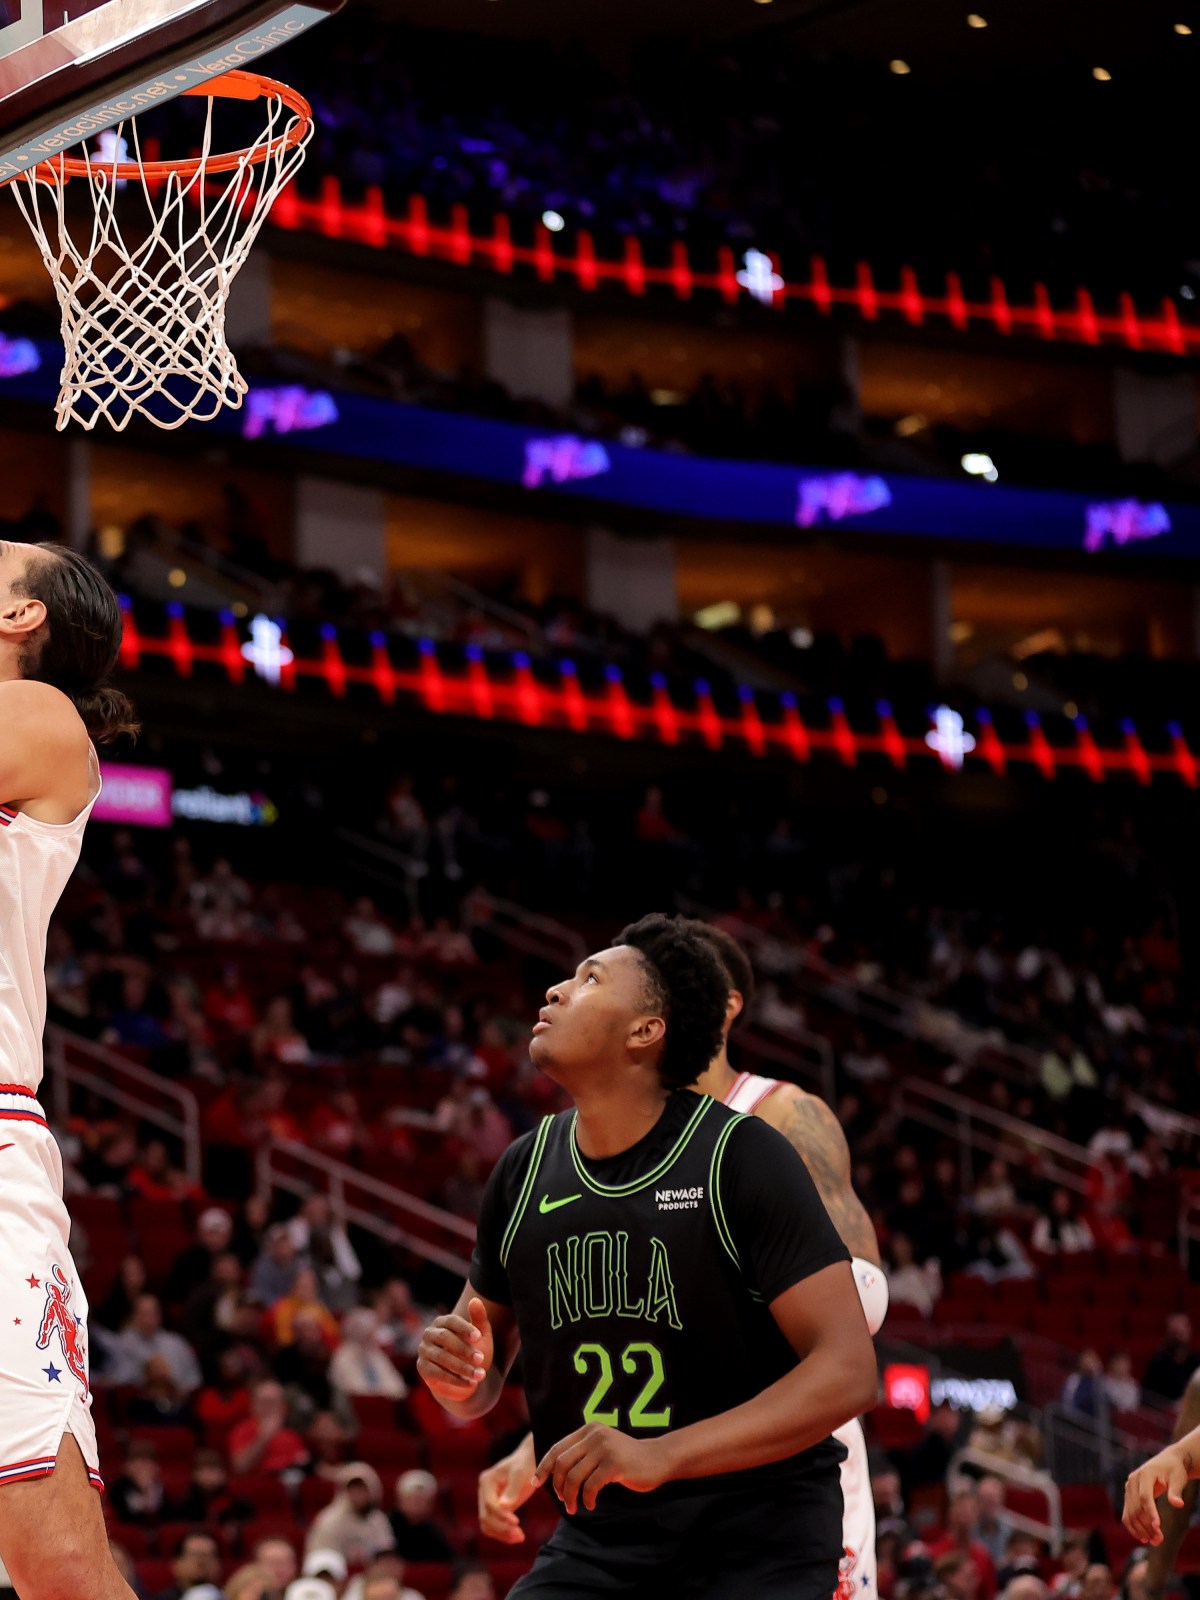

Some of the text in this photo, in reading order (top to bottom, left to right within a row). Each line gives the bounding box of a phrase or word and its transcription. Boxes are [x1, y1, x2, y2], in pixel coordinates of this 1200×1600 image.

[30, 81, 178, 153] veraclinic.net
[655, 1186, 704, 1202] NEWAGE
[658, 1200, 699, 1211] PRODUCTS
[547, 1230, 683, 1330] NOLA
[573, 1342, 672, 1428] 22
